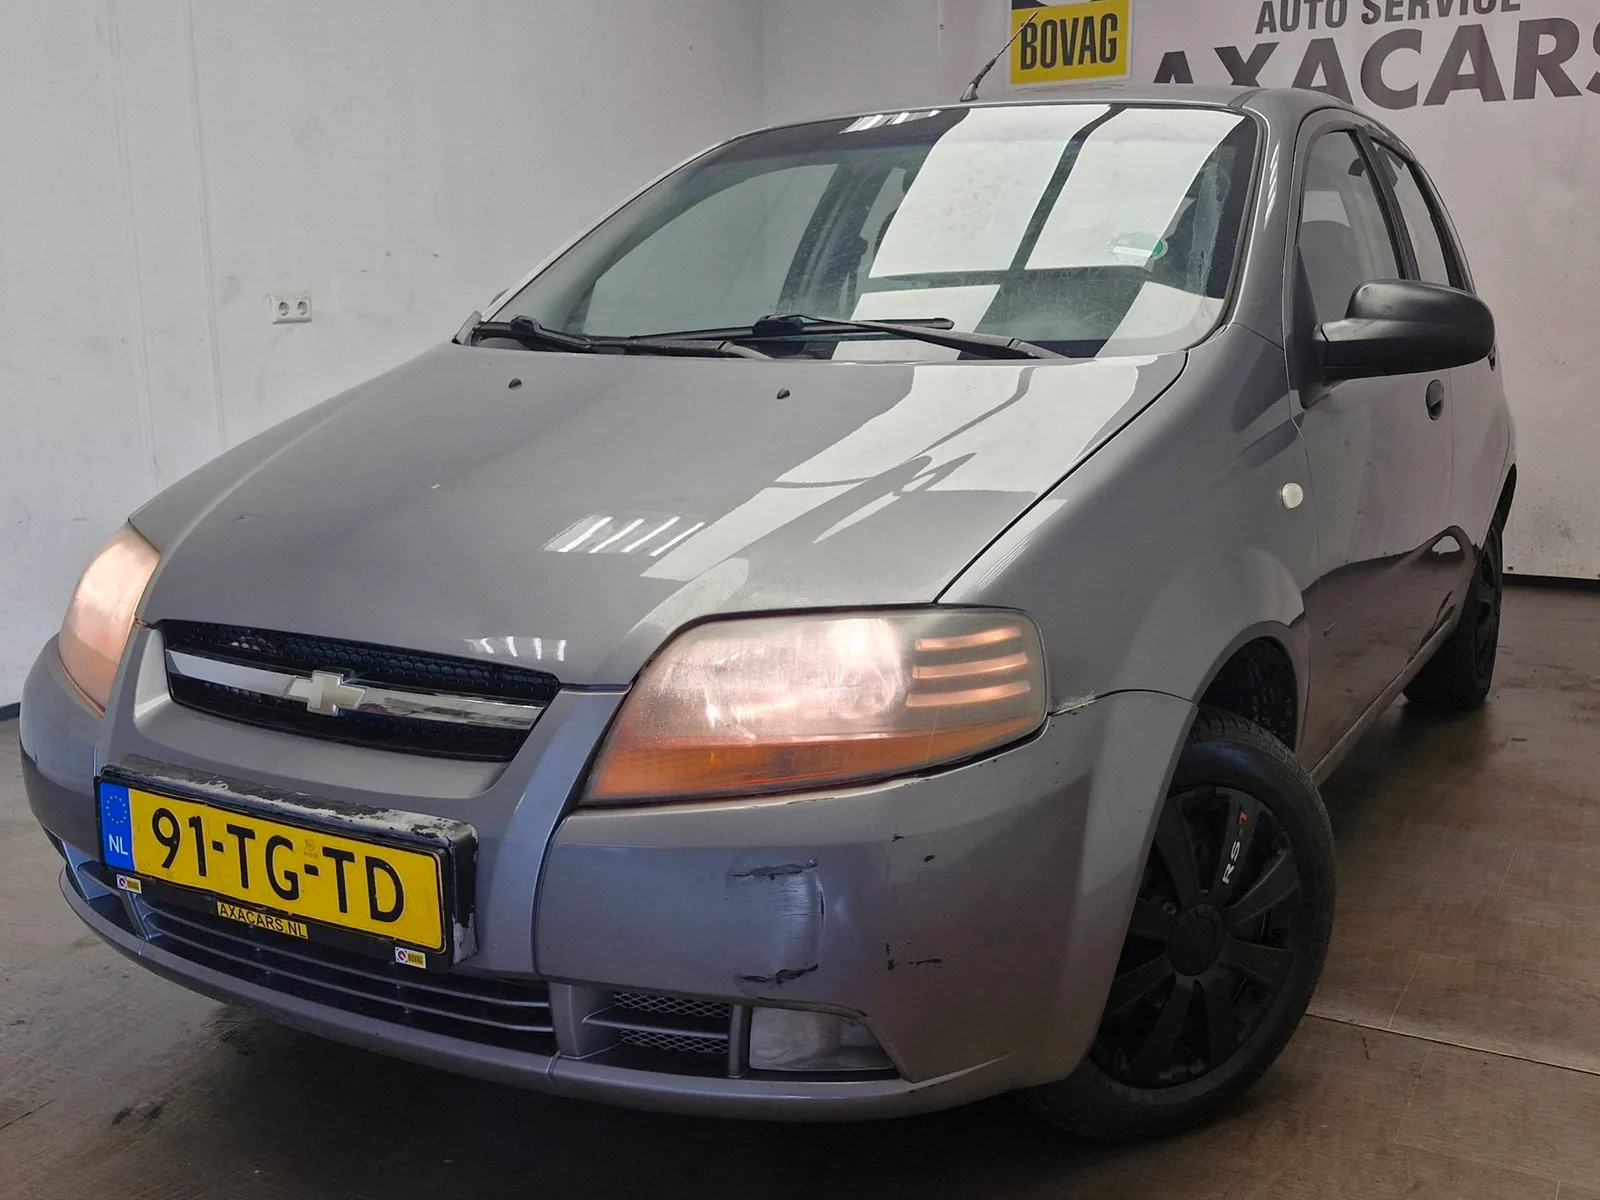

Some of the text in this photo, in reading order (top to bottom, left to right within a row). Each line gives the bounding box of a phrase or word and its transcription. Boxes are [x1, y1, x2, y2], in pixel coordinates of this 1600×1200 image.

[1255, 0, 1348, 34] AUTO
[1020, 13, 1118, 70] BOVAG
[1153, 18, 1600, 110] XACAR
[108, 833, 129, 856] NL
[152, 807, 405, 923] 91-TG-TD
[219, 902, 307, 937] AXACARS.NL
